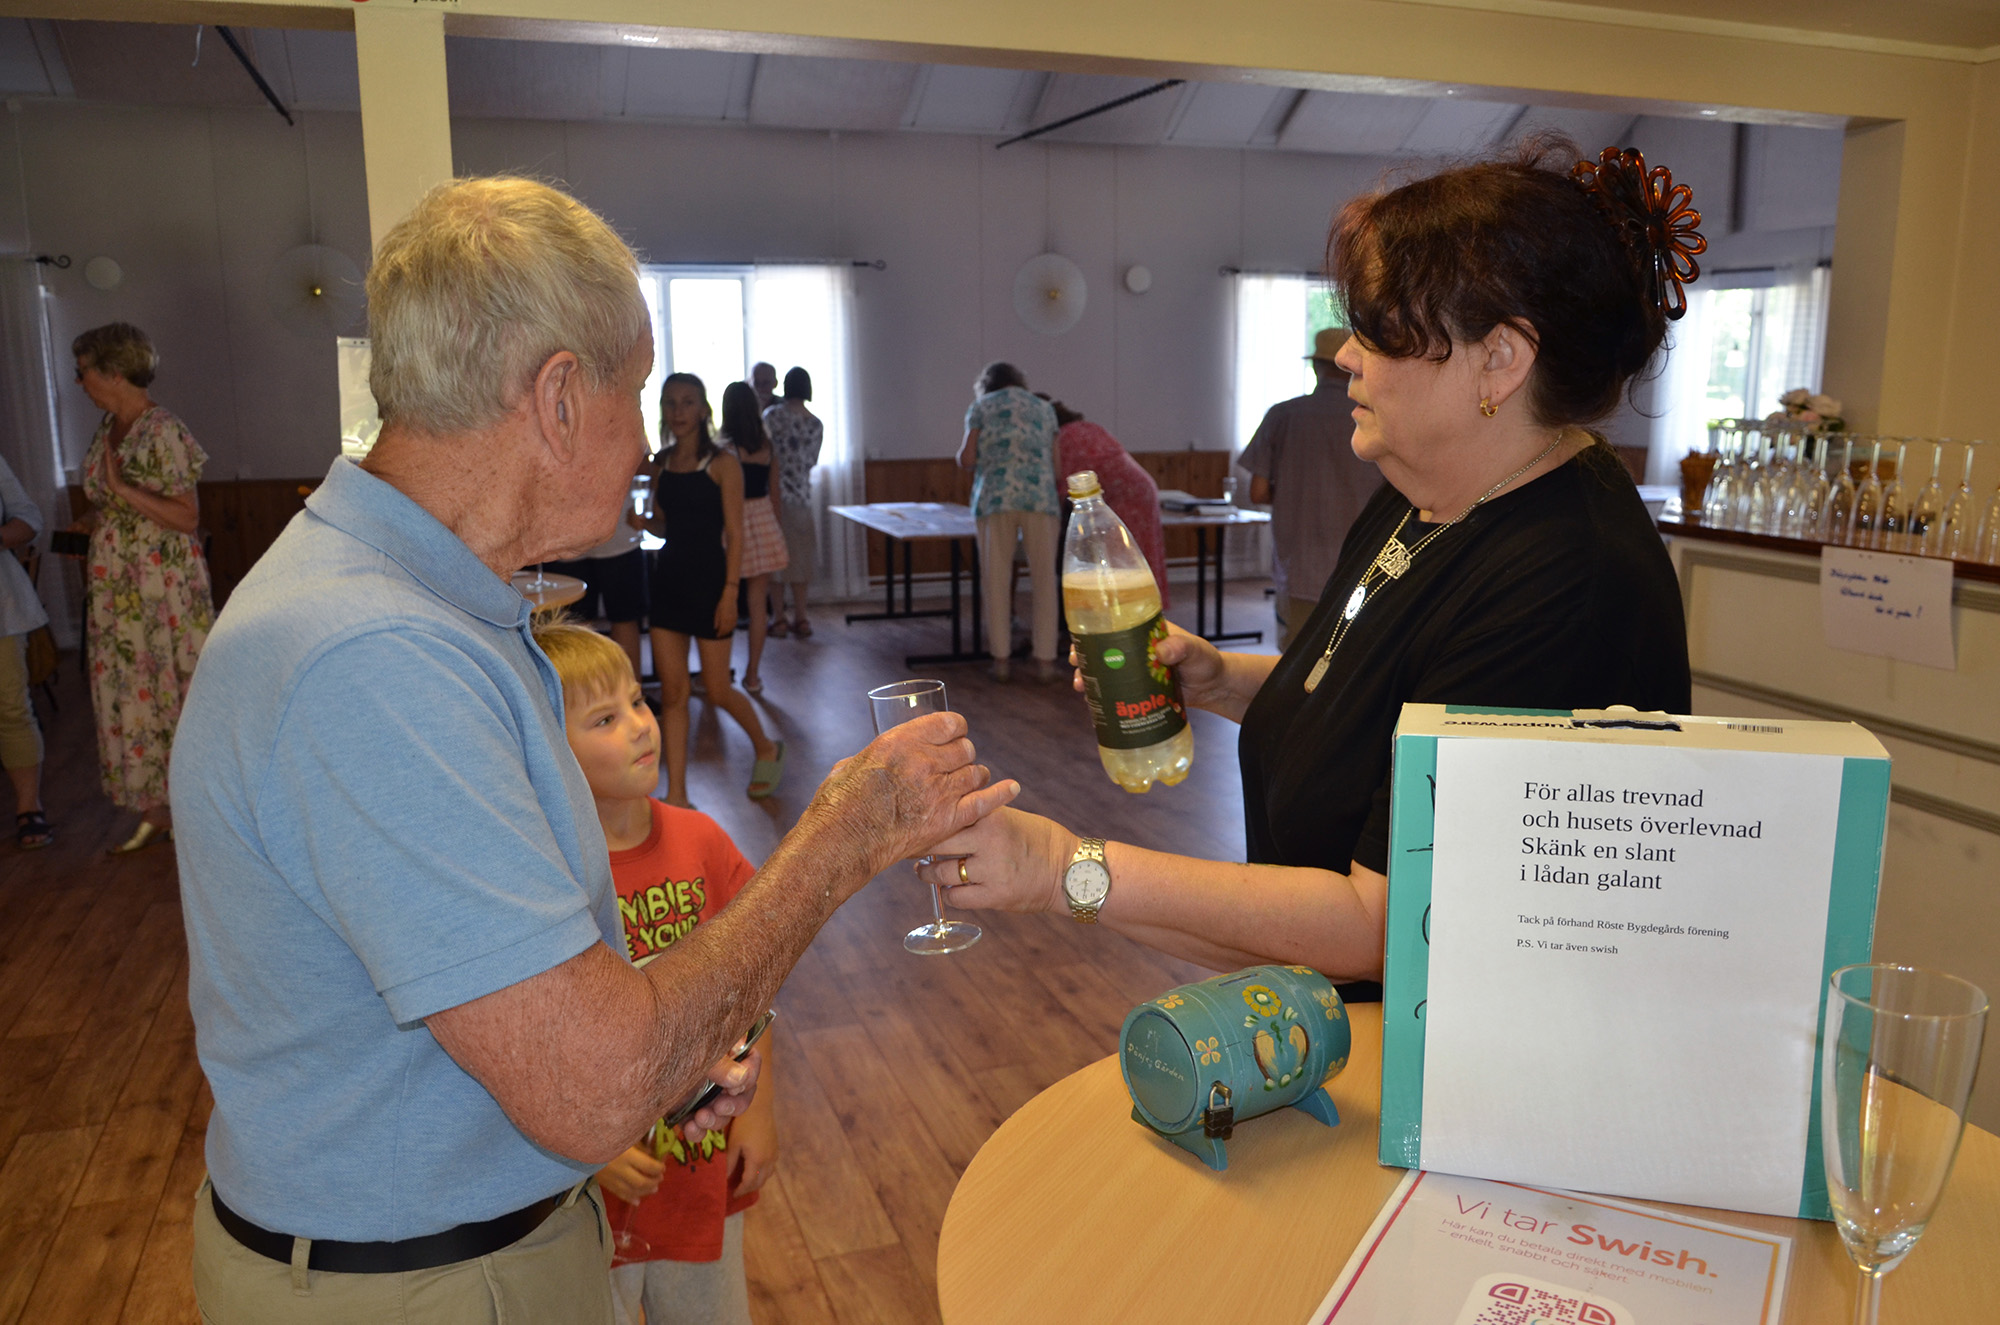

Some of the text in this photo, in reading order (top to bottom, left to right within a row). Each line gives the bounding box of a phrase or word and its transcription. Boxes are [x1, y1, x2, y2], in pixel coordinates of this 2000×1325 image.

[1115, 693, 1166, 719] äpple
[1444, 720, 1578, 730] Tupperware
[1524, 782, 1704, 807] För allas trevnad
[1522, 810, 1762, 839] och husets överlevnad
[1521, 837, 1676, 862] Skänk en slant
[1520, 864, 1662, 891] i lådan galant
[617, 877, 706, 928] MBIES
[1517, 914, 1729, 939] Tack på förhand Röste Bygdegårds förening
[1516, 938, 1618, 954] P.S. Vi tar även swish
[1457, 1194, 1718, 1278] Vi tar Swish.
[1469, 1226, 1494, 1238] kan
[1497, 1233, 1516, 1243] du
[1520, 1239, 1562, 1255] betala
[1566, 1251, 1606, 1268] direkt
[1610, 1264, 1645, 1278] med
[1649, 1272, 1713, 1295] mobilen
[1499, 1244, 1547, 1262] snabbt
[1551, 1258, 1579, 1270] och
